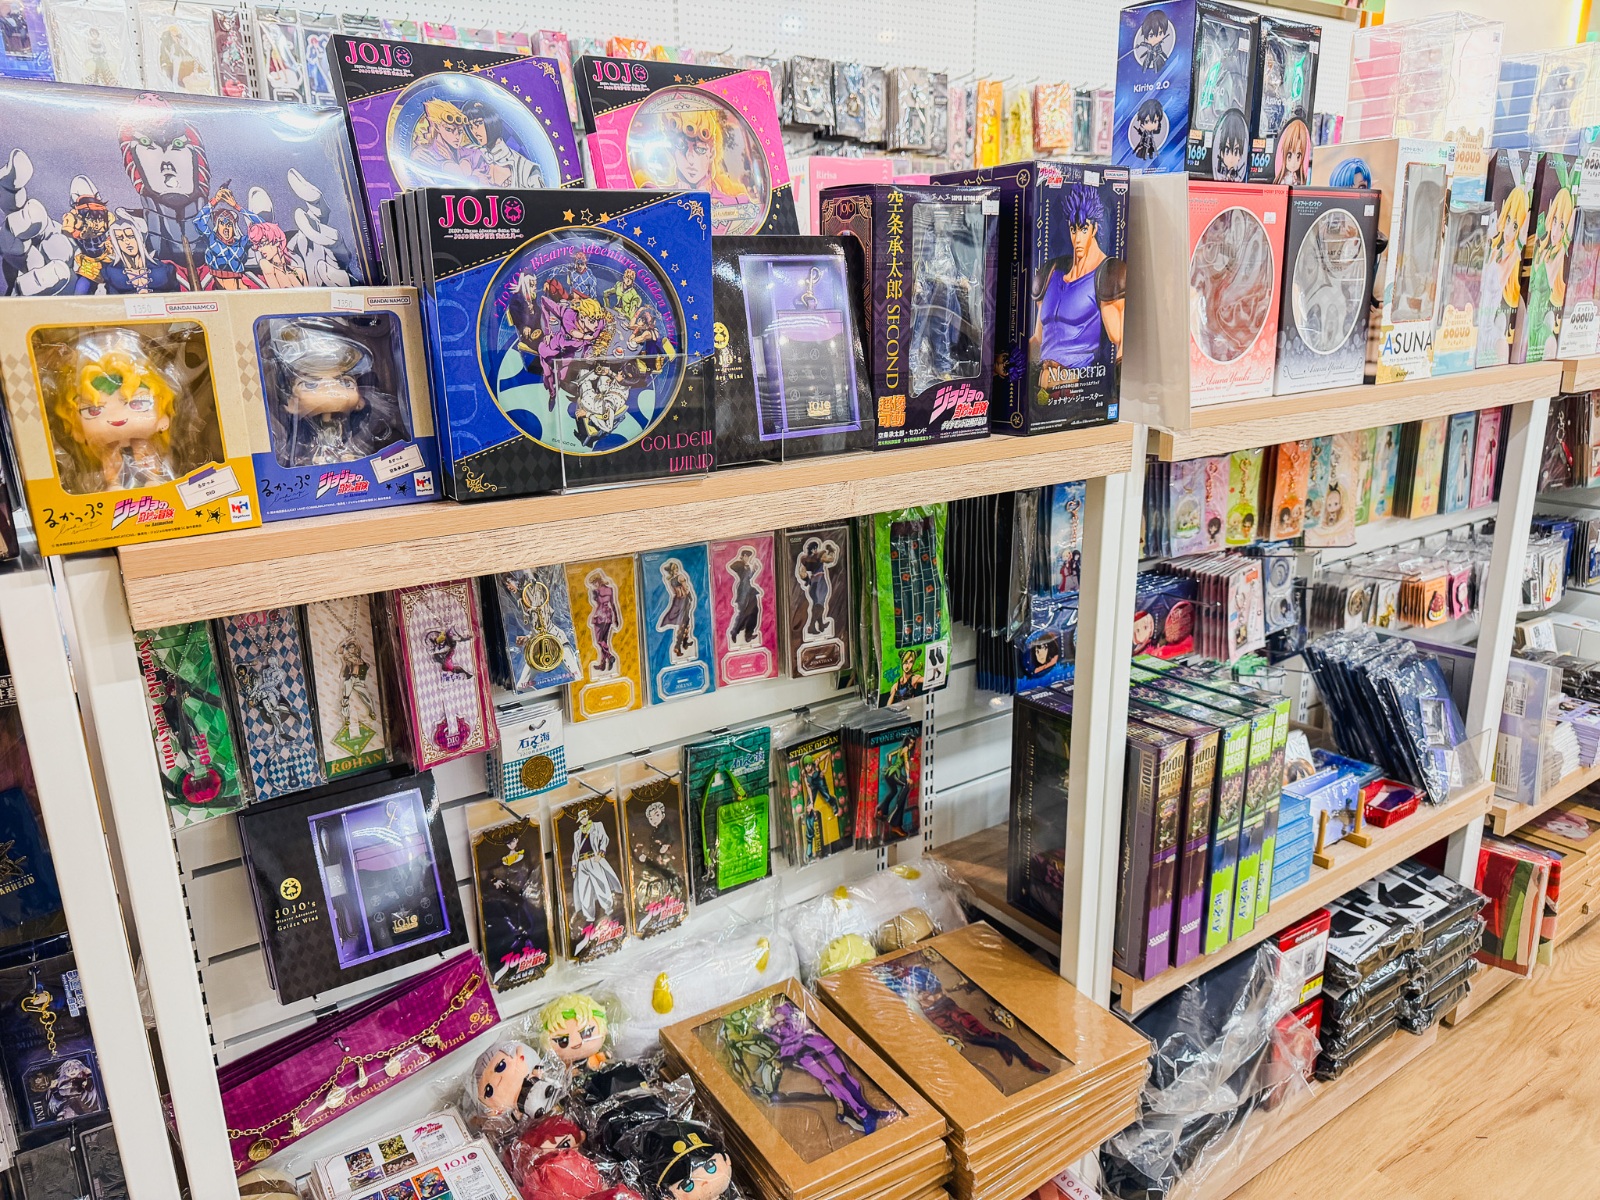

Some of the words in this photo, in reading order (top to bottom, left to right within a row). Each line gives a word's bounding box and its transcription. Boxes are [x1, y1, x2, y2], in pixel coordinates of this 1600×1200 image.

[345, 40, 413, 68] JOJO
[592, 60, 649, 83] JOJO
[1133, 83, 1154, 93] Kirito
[1156, 80, 1170, 91] 2.0
[1187, 145, 1207, 161] 1689
[1251, 153, 1271, 167] 1669
[816, 170, 837, 180] Ririsa
[439, 195, 526, 228] JOJO
[886, 190, 905, 300] 空条承太郎
[530, 245, 575, 272] Bizarre
[580, 241, 637, 271] Adventure
[637, 268, 667, 309] Golden
[132, 304, 152, 314] 1350
[337, 299, 353, 308] 1350
[886, 304, 901, 389] SECOND
[1382, 330, 1433, 356] ASUNA
[929, 383, 985, 425] ジョジョの
[1047, 393, 1104, 406] ジョナサン・ジョースター
[641, 429, 713, 452] GOLDEN
[669, 453, 714, 473] WIND
[260, 474, 311, 497] るかっぷ
[315, 470, 363, 500] ジョジョの
[43, 502, 105, 529] るかっぷ
[111, 495, 170, 531] ジョジョの
[447, 736, 460, 746] DIO
[518, 731, 551, 750] 石之海
[870, 734, 895, 746] STONE
[1252, 725, 1273, 745] 1000
[788, 744, 814, 759] STONE
[814, 735, 839, 752] OCEAN
[1194, 744, 1217, 766] 1000
[1225, 735, 1248, 758] 1000
[330, 751, 383, 775] ROHAN
[1160, 754, 1184, 775] 1000
[1193, 758, 1216, 777] PIECES
[1160, 768, 1183, 787] PIECES
[0, 876, 36, 896] ARHEAD
[274, 901, 317, 919] JOJO's
[275, 914, 295, 924] Bizarre
[295, 909, 317, 919] Adventure
[277, 921, 301, 932] Golden
[302, 915, 319, 926] Wind
[1366, 924, 1378, 932] S
[440, 1032, 467, 1052] Wind
[33, 1100, 45, 1122] LENA
[443, 1151, 478, 1173] JOJO
[1060, 1174, 1091, 1200] SWOR
